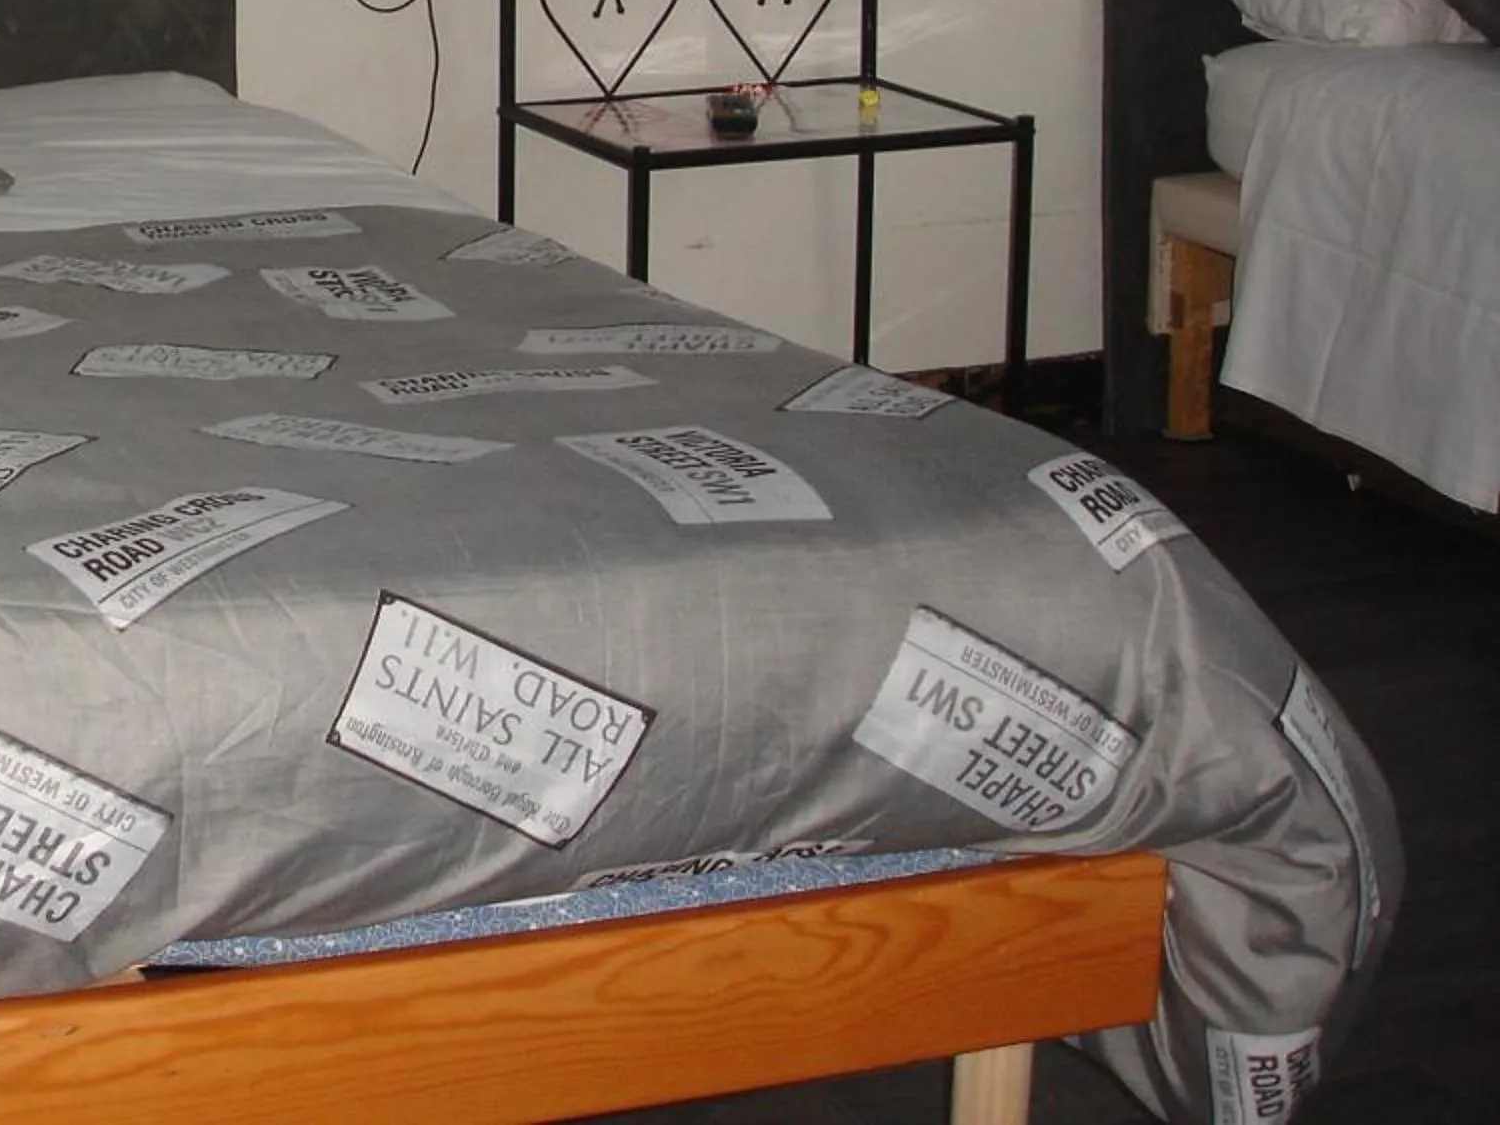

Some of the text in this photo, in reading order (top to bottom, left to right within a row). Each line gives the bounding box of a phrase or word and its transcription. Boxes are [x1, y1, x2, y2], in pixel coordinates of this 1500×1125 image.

[615, 434, 703, 471] STREET
[689, 468, 756, 506] SW1
[665, 430, 778, 479] VICTORIA
[53, 493, 266, 560] CHARING CROSS
[83, 537, 166, 582] ROAD
[119, 582, 153, 610] CITY
[151, 570, 171, 588] OF
[959, 644, 1073, 723] WESTMINSTER
[374, 653, 615, 785] ALL SAINTS
[906, 667, 1098, 803] STREET SW1
[62, 787, 90, 813] OF
[96, 805, 139, 835] CITY
[955, 748, 1067, 827] CHAPEL
[1245, 1054, 1285, 1119] ROAD
